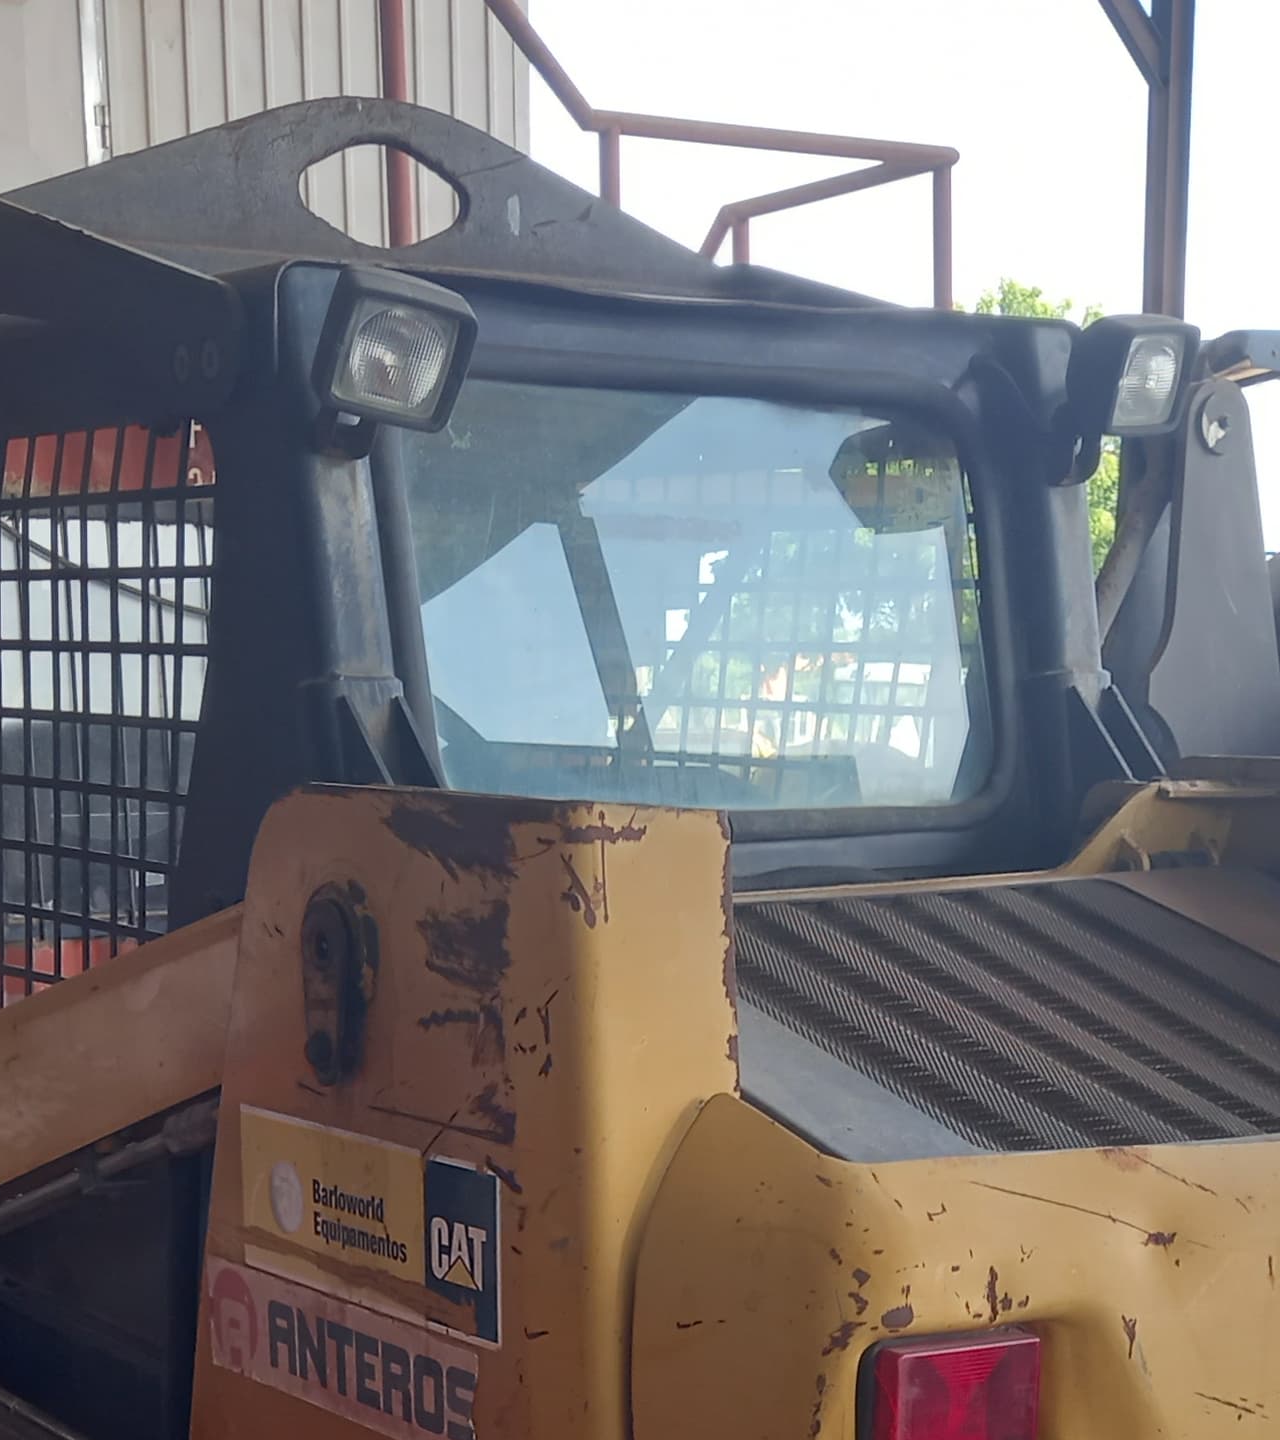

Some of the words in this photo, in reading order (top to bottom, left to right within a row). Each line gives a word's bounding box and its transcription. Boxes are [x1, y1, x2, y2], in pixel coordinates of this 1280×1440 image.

[312, 1179, 384, 1223] Barloworld
[313, 1211, 408, 1264] Equipamentos
[430, 1217, 487, 1291] CAT
